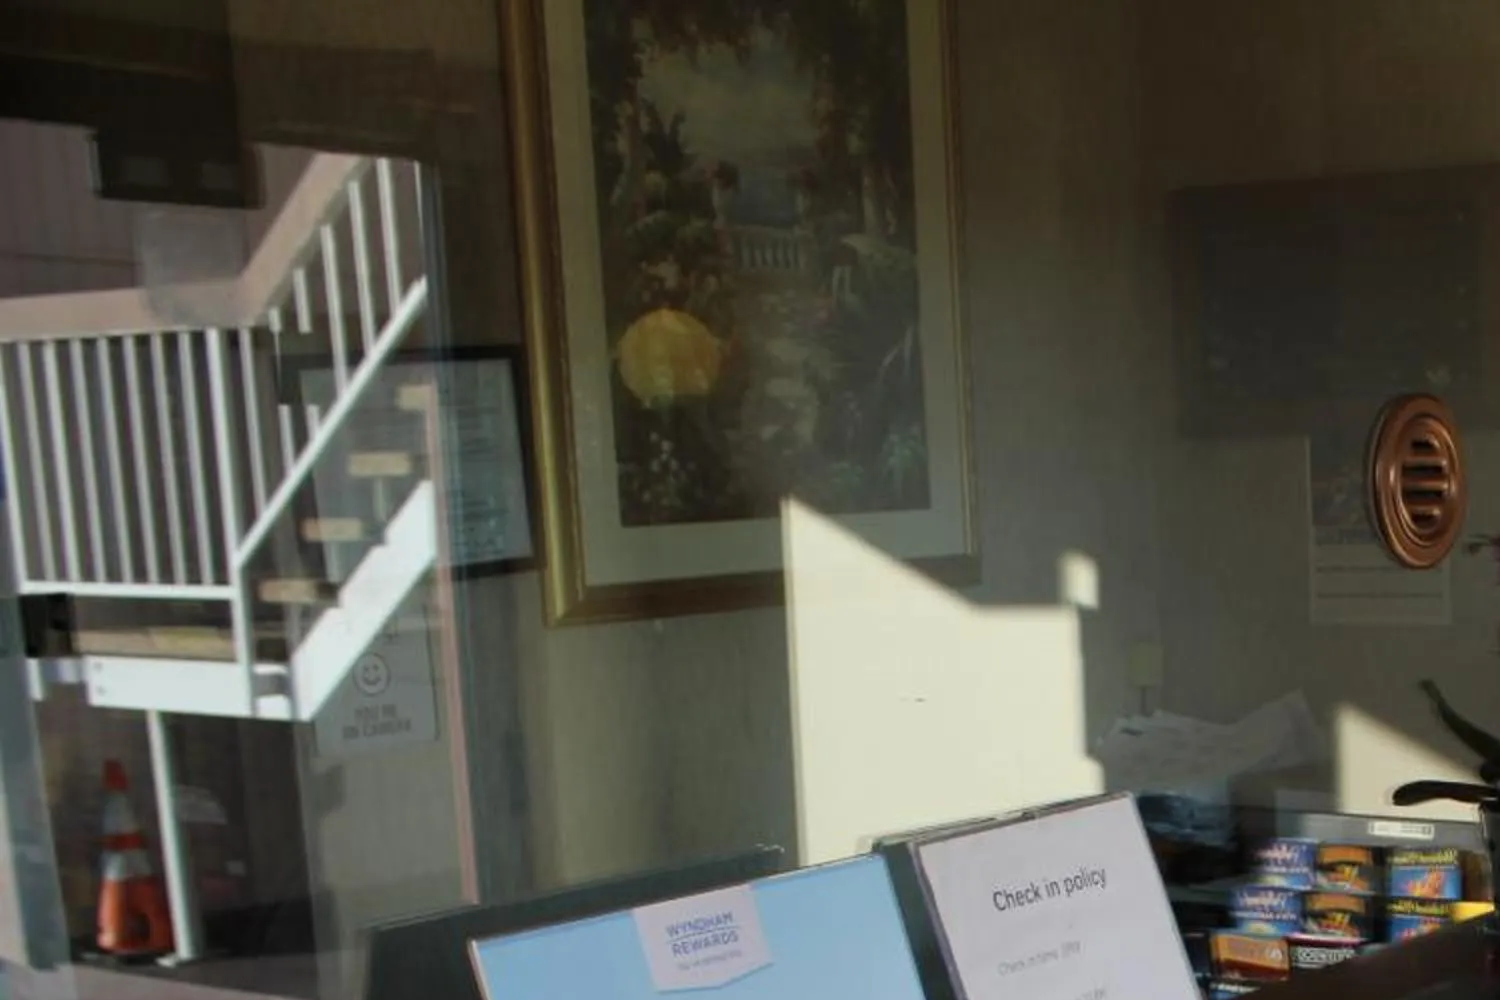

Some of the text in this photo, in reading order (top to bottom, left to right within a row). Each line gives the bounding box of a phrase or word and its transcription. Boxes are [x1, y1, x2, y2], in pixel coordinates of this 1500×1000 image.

[992, 865, 1107, 912] Check in policy
[666, 911, 735, 939] WYNDHAM
[671, 929, 741, 959] REWARDS
